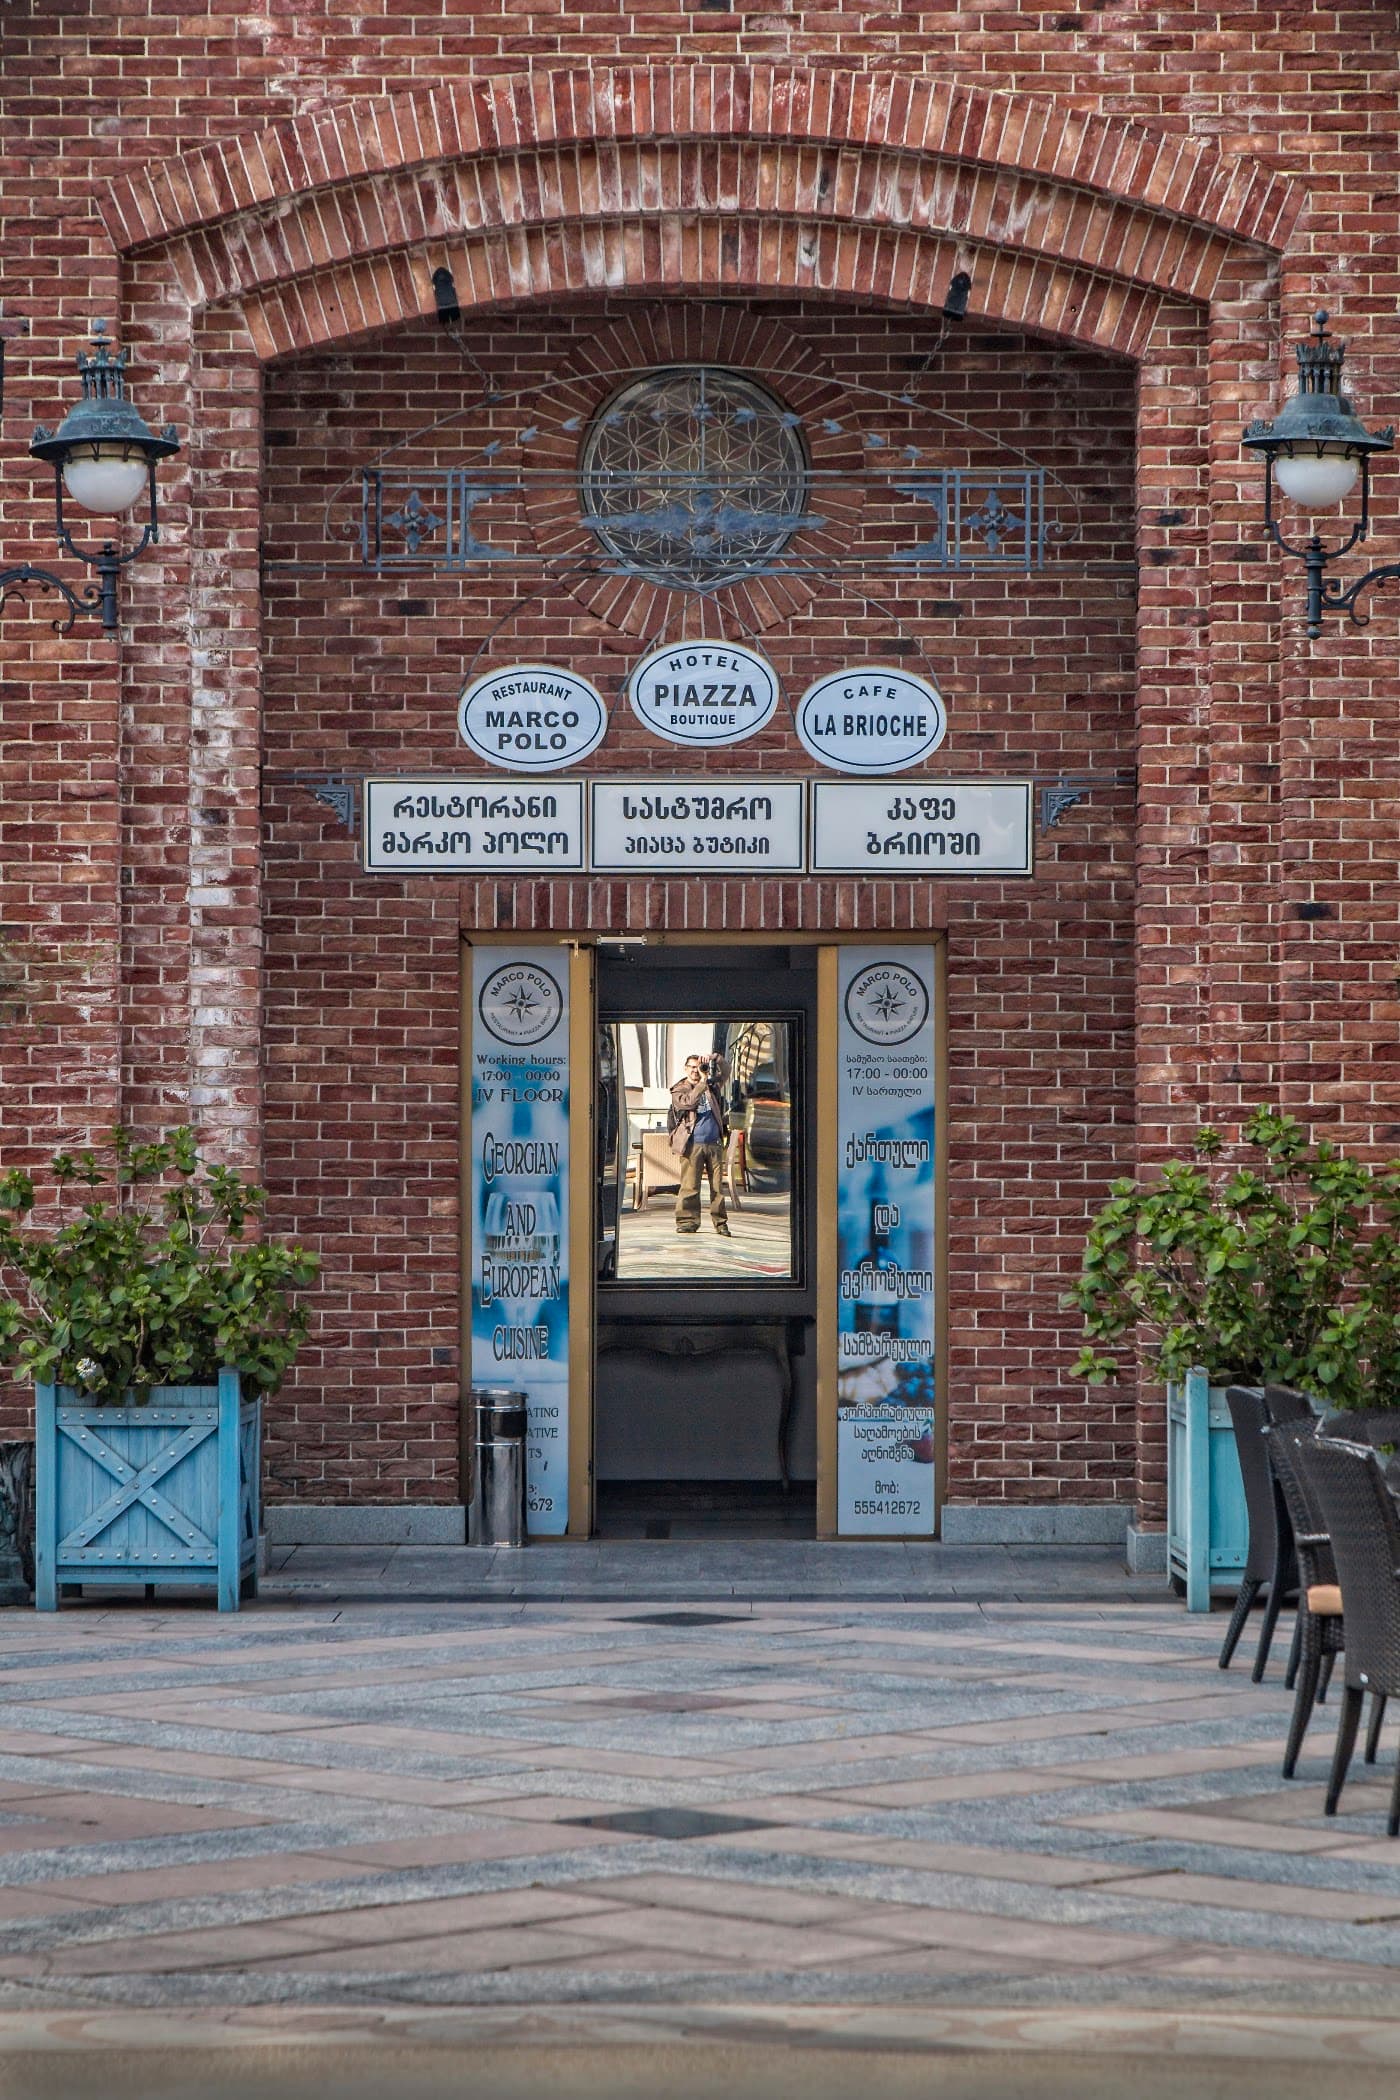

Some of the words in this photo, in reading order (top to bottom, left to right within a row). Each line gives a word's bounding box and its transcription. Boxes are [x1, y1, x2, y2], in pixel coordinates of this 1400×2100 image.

[669, 654, 740, 673] HOTEL
[491, 681, 573, 701] RESTAURANT
[654, 684, 758, 707] PIAZZA
[843, 685, 897, 700] CAFE
[485, 711, 580, 728] MARCO
[670, 714, 736, 726] BOUTIQUE
[814, 714, 837, 736] LA
[843, 714, 927, 737] BRIOCHE
[498, 733, 567, 750] POLO
[393, 795, 557, 819] რესტორანი
[623, 796, 772, 820] სასტუმრო
[887, 797, 956, 821] კაფე
[382, 831, 471, 854] მარკო
[482, 831, 569, 854] პოლო
[625, 836, 686, 854] პიაცა
[693, 836, 770, 854] ბუტიკი
[866, 831, 981, 855] ბრიოში
[490, 972, 524, 997] MARCO
[527, 973, 551, 997] POLO
[856, 972, 890, 997] MARCO
[892, 973, 917, 997] POLO
[476, 1054, 526, 1066] Working
[530, 1054, 566, 1065] hours:
[482, 1071, 511, 1081] 17:00
[525, 1071, 560, 1081] 00:00
[847, 1068, 881, 1079] 17:00
[893, 1068, 928, 1079] 00:00
[477, 1088, 494, 1102] IV
[500, 1088, 563, 1102] FLOOR
[852, 1086, 863, 1096] IV
[866, 1086, 922, 1098] სართული
[846, 1132, 928, 1169] ქართული
[505, 1203, 537, 1236] AND
[876, 1204, 899, 1234] და
[843, 1262, 933, 1299] ევროპული
[493, 1325, 548, 1361] CUISINE
[843, 1332, 932, 1362] სამზარეულო
[854, 1501, 921, 1515] 555412672
